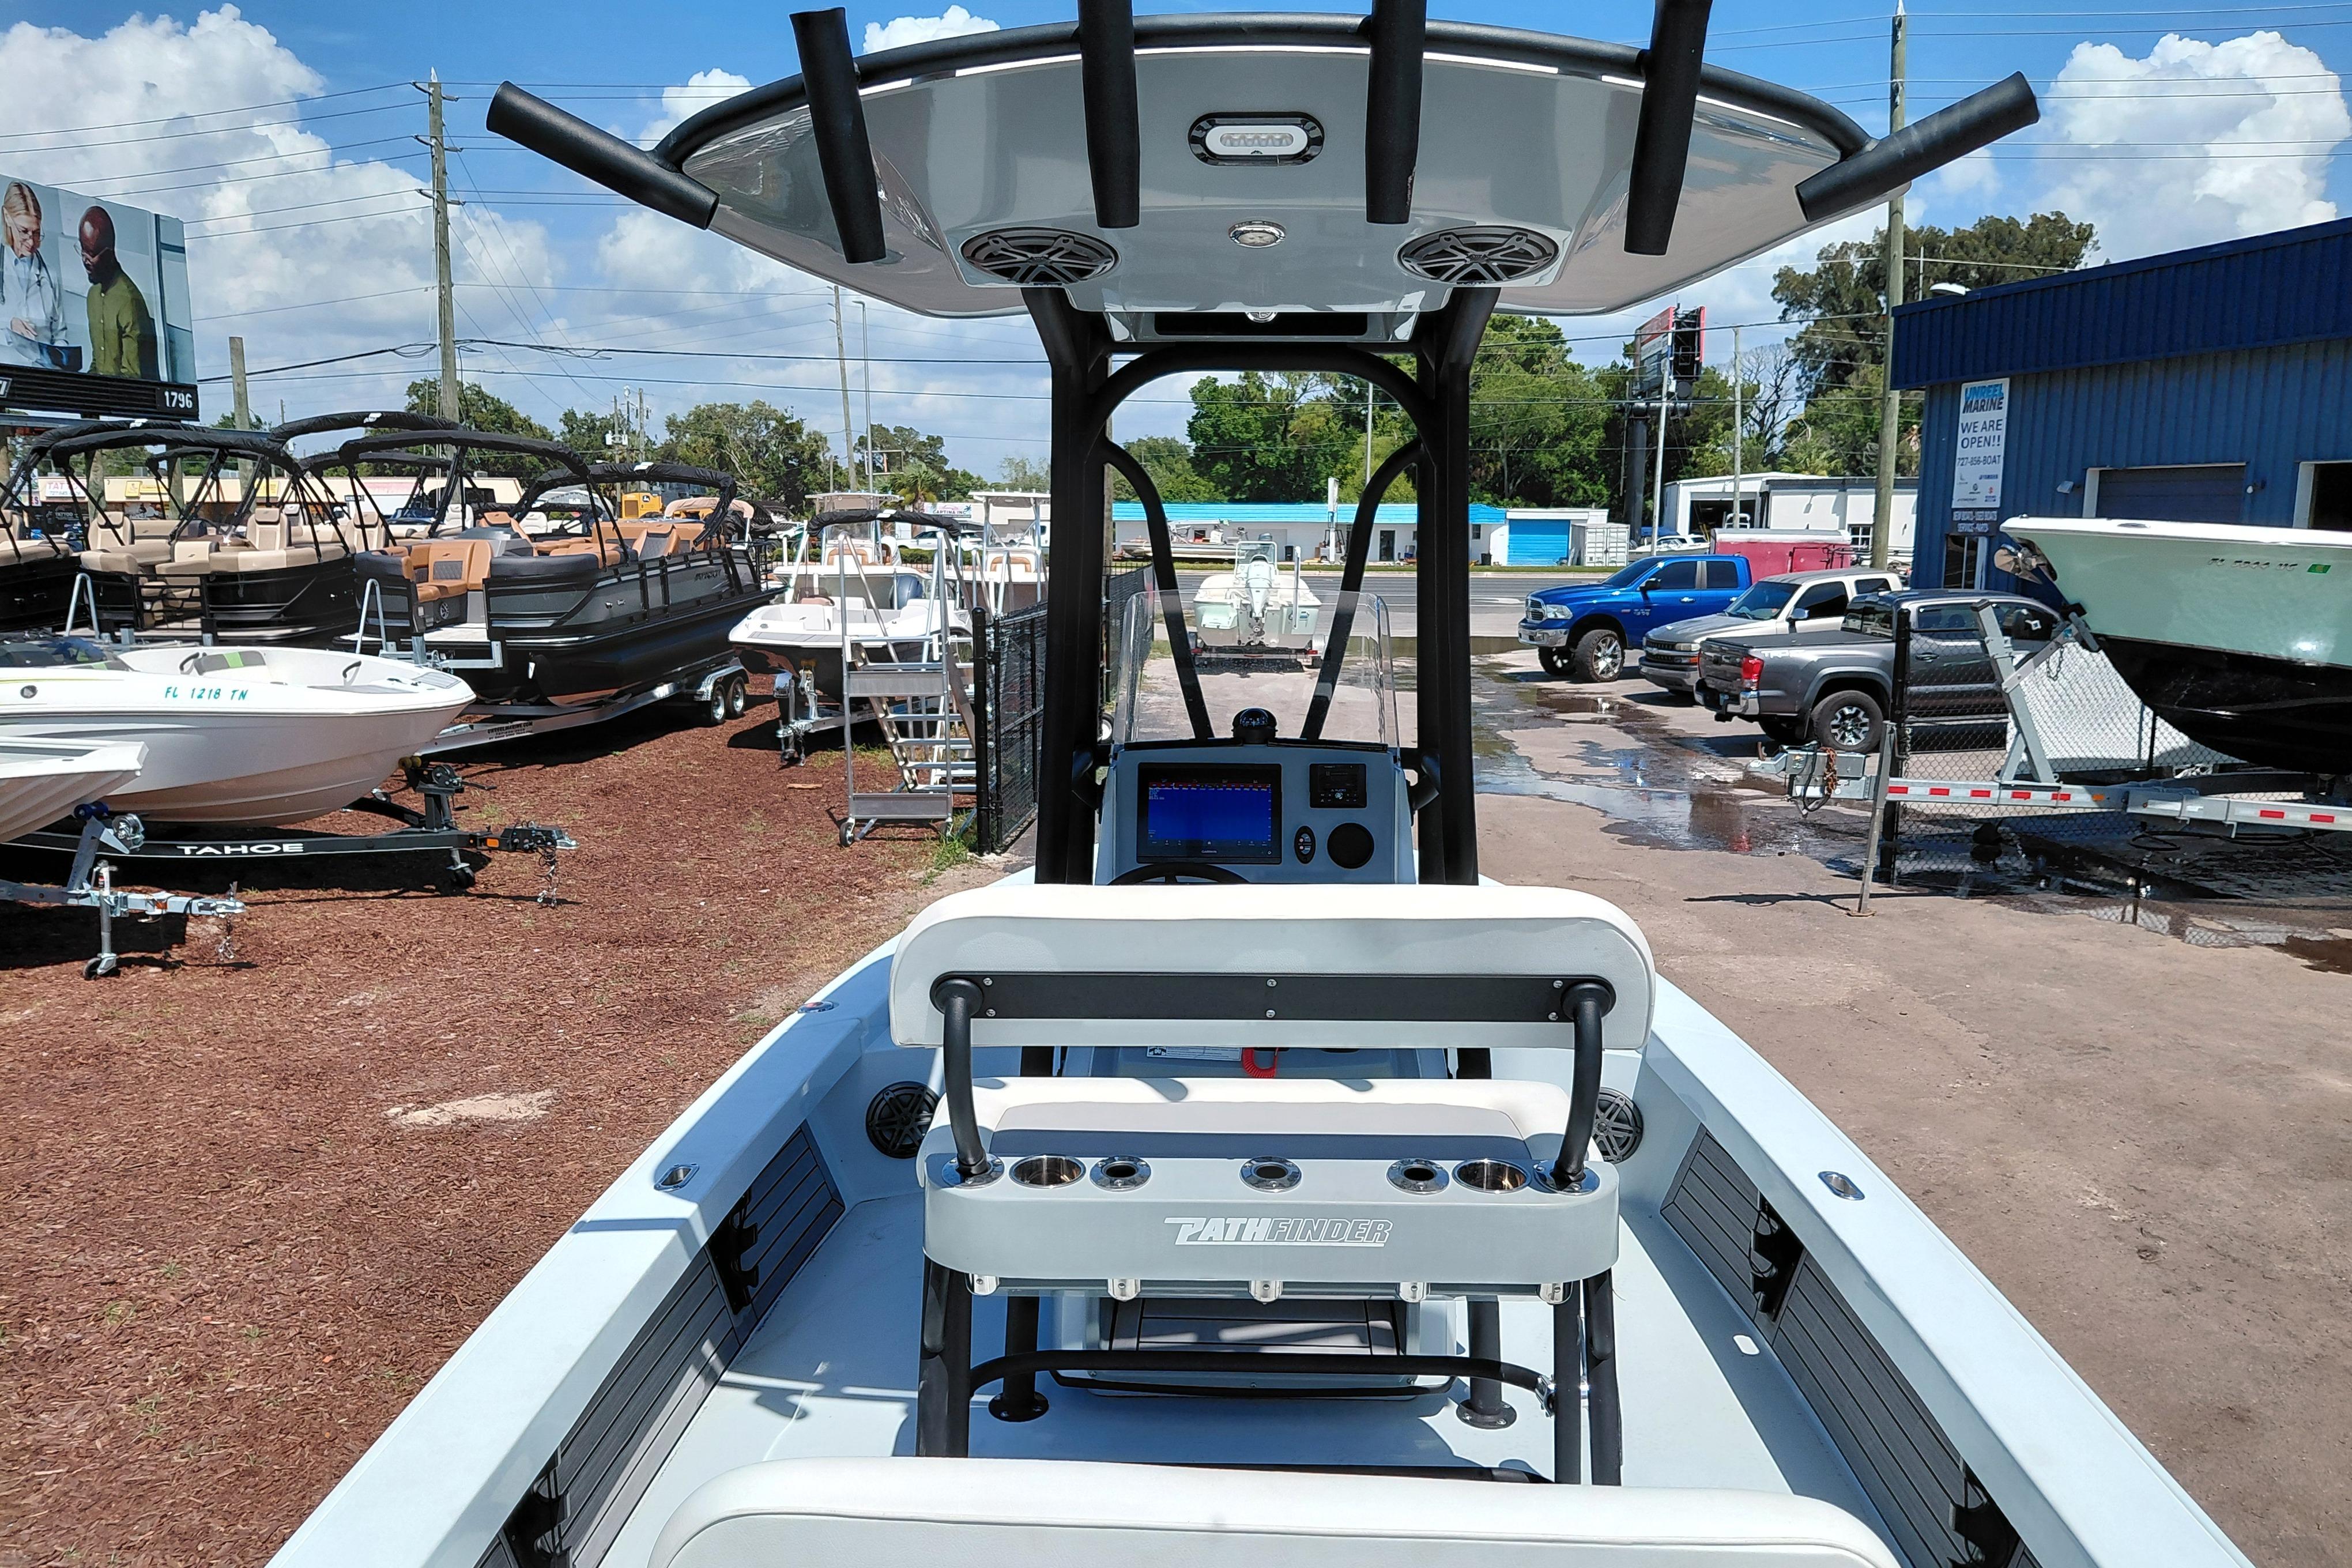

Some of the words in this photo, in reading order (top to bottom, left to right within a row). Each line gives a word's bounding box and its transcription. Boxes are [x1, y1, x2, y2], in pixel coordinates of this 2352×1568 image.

[1965, 384, 2004, 399] UNREEL
[164, 390, 193, 409] 1796
[1962, 397, 2004, 413] MARINE
[1961, 421, 1978, 434] WE
[1981, 419, 2003, 432] ARE
[1961, 435, 2000, 449] OPEN!!
[1957, 455, 2001, 466] 727-856-BOAT
[165, 686, 178, 699] FL
[191, 687, 221, 700] 1218
[231, 689, 249, 701] TN
[176, 843, 304, 855] TAHOE
[1164, 1217, 1393, 1247] PATHFINDER
